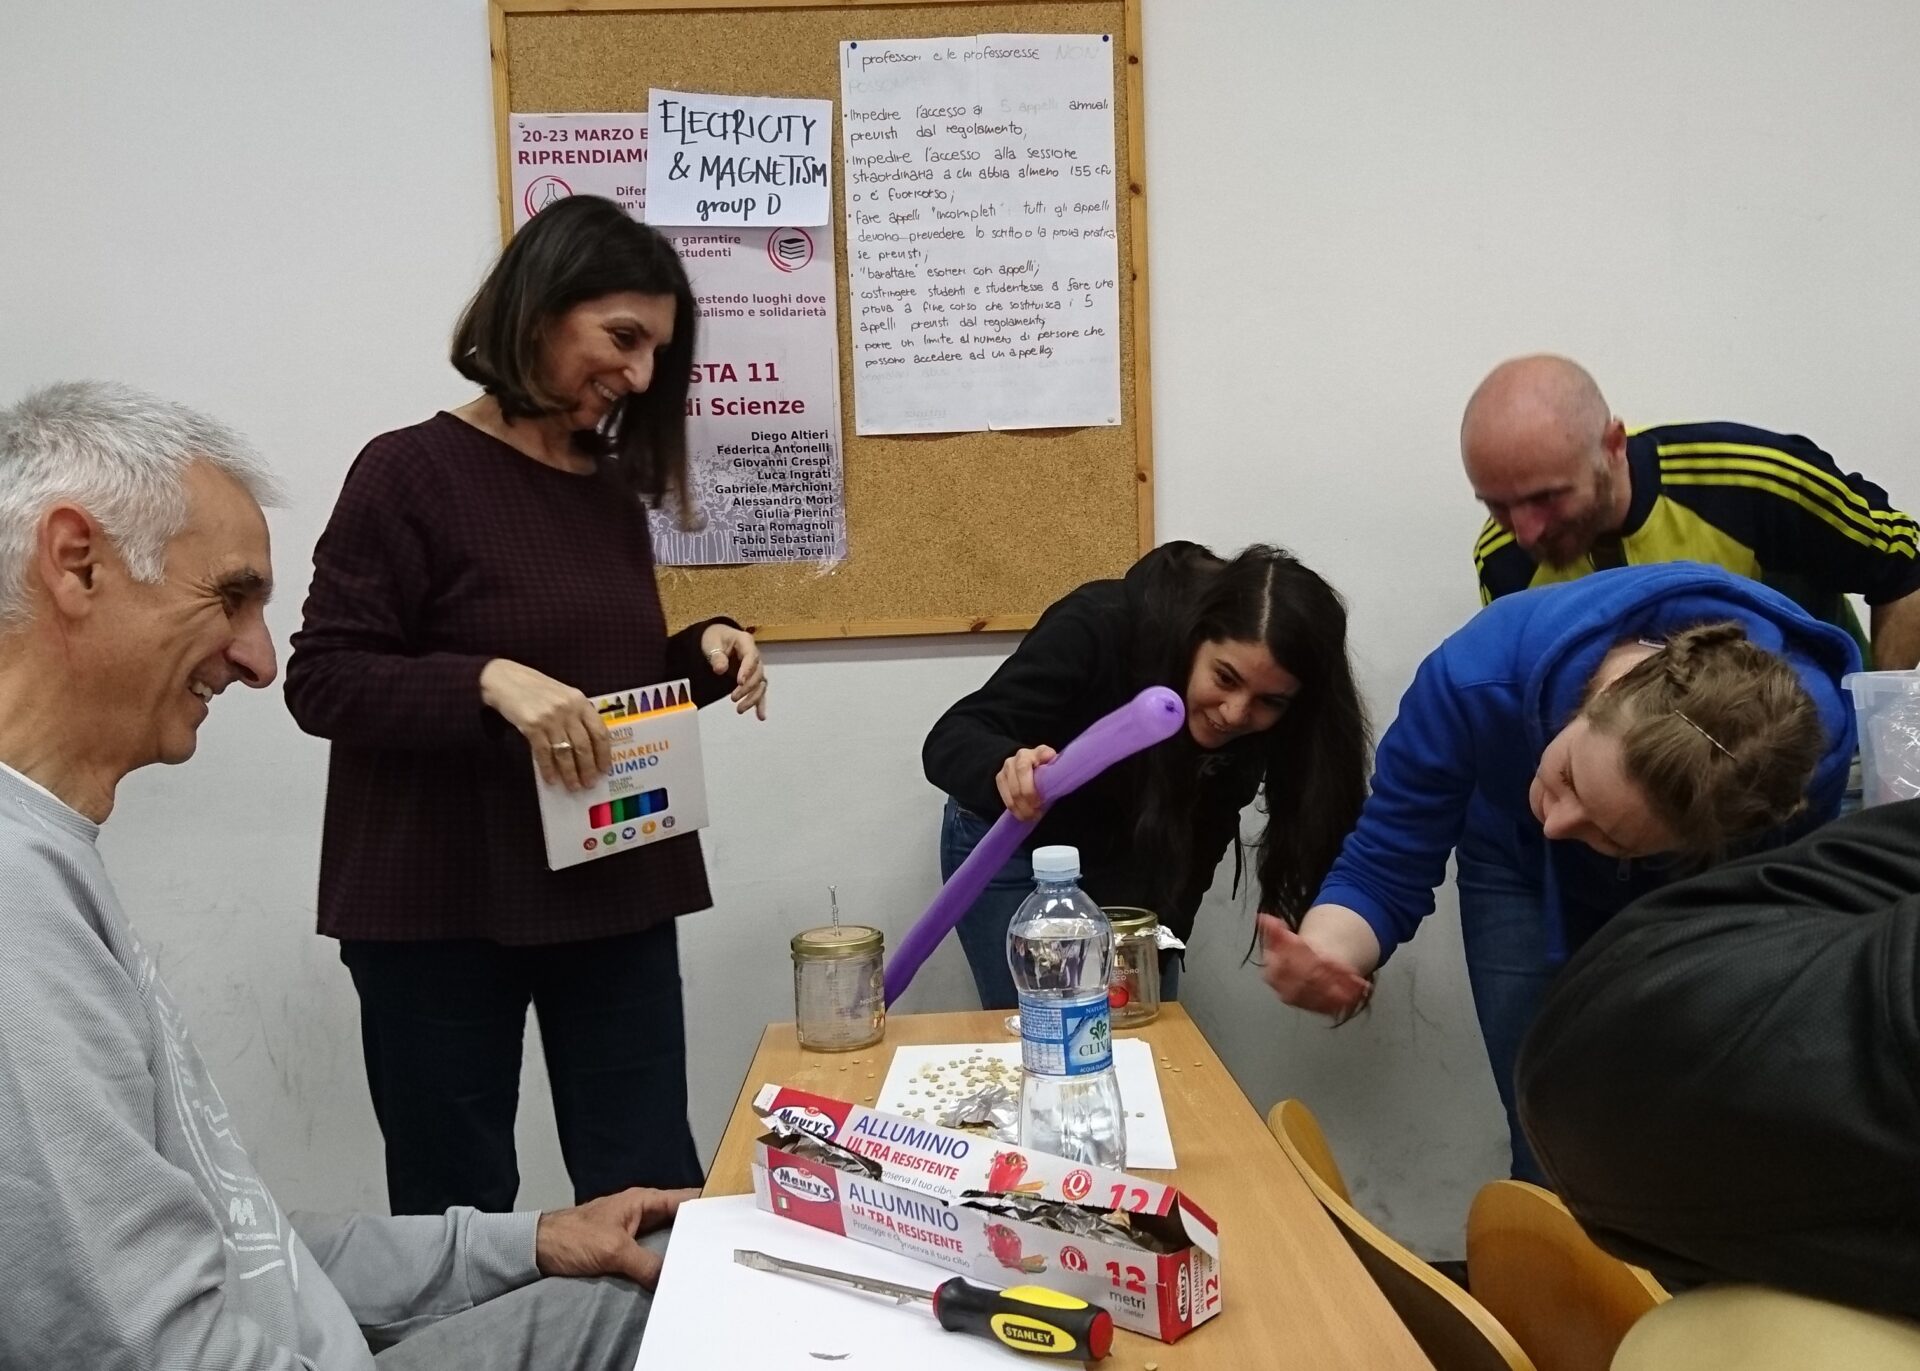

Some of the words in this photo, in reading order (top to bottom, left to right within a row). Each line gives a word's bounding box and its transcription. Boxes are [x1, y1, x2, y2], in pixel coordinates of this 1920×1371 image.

[862, 51, 921, 72] professori
[933, 53, 942, 61] e
[947, 48, 957, 60] le
[964, 46, 1040, 62] professoresse
[916, 105, 966, 118] l'accesso
[658, 100, 817, 145] ELECTRICITY
[522, 130, 568, 142] 20-23
[575, 128, 634, 141] MARZO
[851, 126, 898, 147] previsti
[916, 124, 936, 137] dal
[925, 147, 980, 162] l'accesso
[994, 146, 1016, 160] alla
[1027, 147, 1077, 160] sessione
[668, 151, 691, 181] &
[700, 154, 827, 190] MAGNETISM
[852, 168, 934, 184] straordinaria
[943, 169, 952, 179] a
[956, 168, 972, 178] chi
[979, 166, 1010, 179] abbia
[1018, 164, 1059, 178] almeno
[1070, 165, 1092, 177] 155
[696, 197, 756, 221] group
[768, 193, 781, 215] D
[889, 208, 920, 224] appelli
[1024, 201, 1046, 214] tutti
[1055, 202, 1067, 218] gli
[1073, 200, 1110, 214] appelli
[681, 235, 741, 246] garantire
[858, 229, 900, 242] devono
[909, 226, 965, 243] prevedere
[976, 225, 985, 239] lo
[992, 226, 1022, 239] scritto
[1037, 226, 1046, 237] la
[1053, 228, 1079, 240] prova
[1083, 226, 1116, 240] pratica
[678, 248, 731, 257] studenti
[858, 250, 870, 259] se
[972, 267, 993, 276] con
[861, 285, 917, 301] costringere
[928, 284, 966, 297] studenti
[974, 286, 981, 294] e
[986, 280, 1044, 294] studentesse
[1051, 281, 1059, 291] a
[1067, 277, 1091, 291] fare
[1095, 279, 1114, 289] una
[753, 294, 791, 306] luoghi
[796, 294, 826, 304] dove
[862, 304, 894, 315] prova
[904, 303, 912, 313] a
[923, 301, 945, 313] fine
[950, 303, 977, 312] corso
[985, 301, 1003, 311] che
[1009, 299, 1061, 310] sostituisca
[1084, 294, 1094, 307] 5
[695, 307, 744, 317] ualismo
[748, 309, 755, 317] e
[760, 306, 827, 317] solidarietà
[860, 316, 896, 334] appelli
[910, 316, 949, 332] previsti
[959, 316, 977, 327] dal
[865, 342, 892, 351] porre
[901, 339, 914, 348] un
[923, 333, 953, 345] limite
[960, 333, 970, 344] al
[973, 335, 1011, 344] numero
[1020, 332, 1030, 341] di
[1084, 326, 1105, 336] che
[865, 357, 905, 368] possono
[913, 350, 963, 364] accedere
[969, 349, 985, 360] ad
[992, 350, 1005, 359] un
[688, 364, 738, 384] STA
[748, 362, 779, 383] 11
[711, 397, 805, 416] Scienze
[751, 431, 787, 443] Diego
[791, 430, 828, 440] Altieri
[717, 445, 770, 455] Federica
[774, 443, 830, 454] Antonelli
[733, 457, 787, 468] Giovanni
[791, 456, 830, 468] Crespi
[757, 471, 786, 480] Luca
[790, 470, 831, 481] Ingrati
[715, 484, 767, 494] Gabriele
[771, 483, 832, 493] Marchioni
[733, 496, 801, 507] Alessandro
[806, 495, 833, 505] Mori
[754, 509, 790, 519] Giulia
[794, 508, 833, 518] Pierini
[737, 523, 765, 532] Sara
[769, 521, 834, 533] Romagnoli
[733, 535, 766, 545] Fabio
[770, 534, 834, 544] Sebastiani
[741, 548, 794, 558] Samuele
[797, 547, 835, 556] Torelli
[608, 755, 659, 777] JUMBO
[853, 1115, 969, 1160] ALLUMINIO
[846, 1136, 890, 1161] ULTRA
[890, 1151, 960, 1181] RESISTENTE
[882, 1170, 912, 1185] onserva
[918, 1179, 933, 1191] tuo
[849, 1183, 959, 1231] ALLUMINIO
[1110, 1184, 1149, 1213] 12
[897, 1222, 963, 1253] RESISTENTE
[1106, 1261, 1147, 1294] 12
[1109, 1291, 1145, 1310] metri
[1205, 1274, 1218, 1311] 12
[1006, 1326, 1051, 1343] STANLEY
